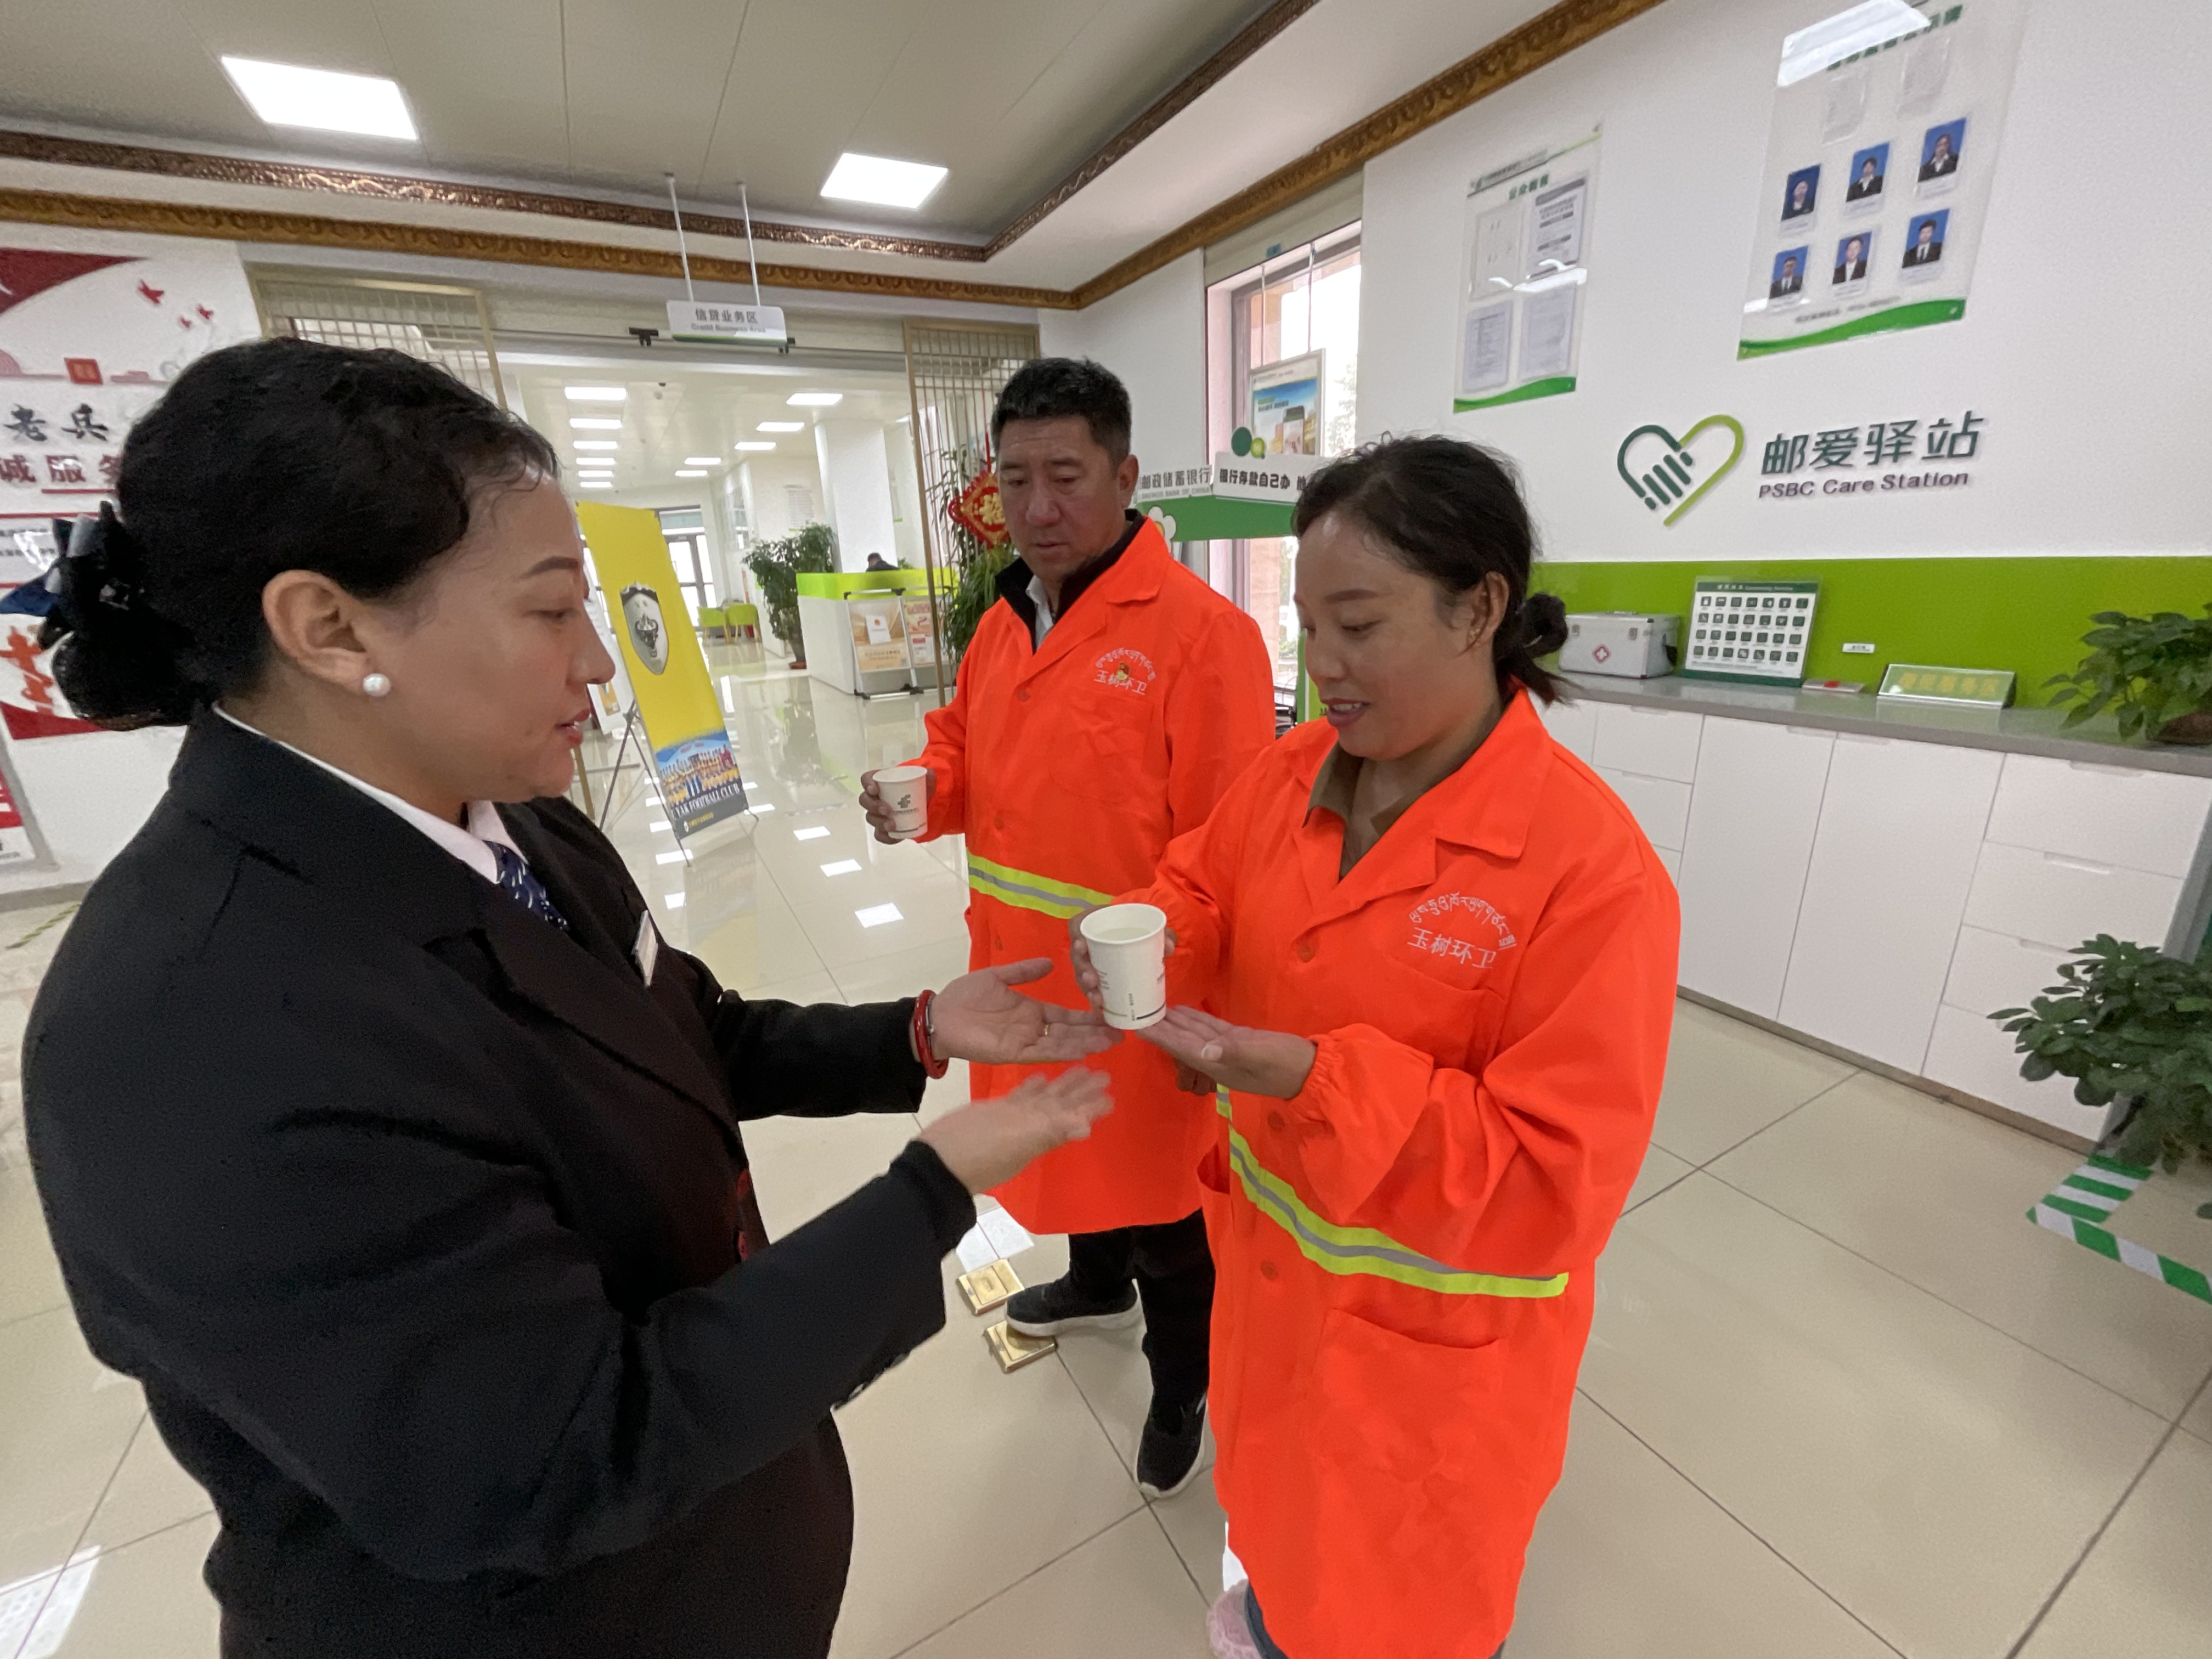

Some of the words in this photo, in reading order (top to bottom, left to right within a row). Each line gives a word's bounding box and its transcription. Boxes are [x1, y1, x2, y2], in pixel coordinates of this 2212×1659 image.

[695, 308, 758, 324] 信贷业务区
[1761, 410, 1985, 475] 邮爱驿站
[1759, 481, 1815, 498] PSBC
[1822, 478, 1874, 494] Care
[1881, 472, 1969, 490] Station
[1407, 927, 1497, 969] 玉树环卫
